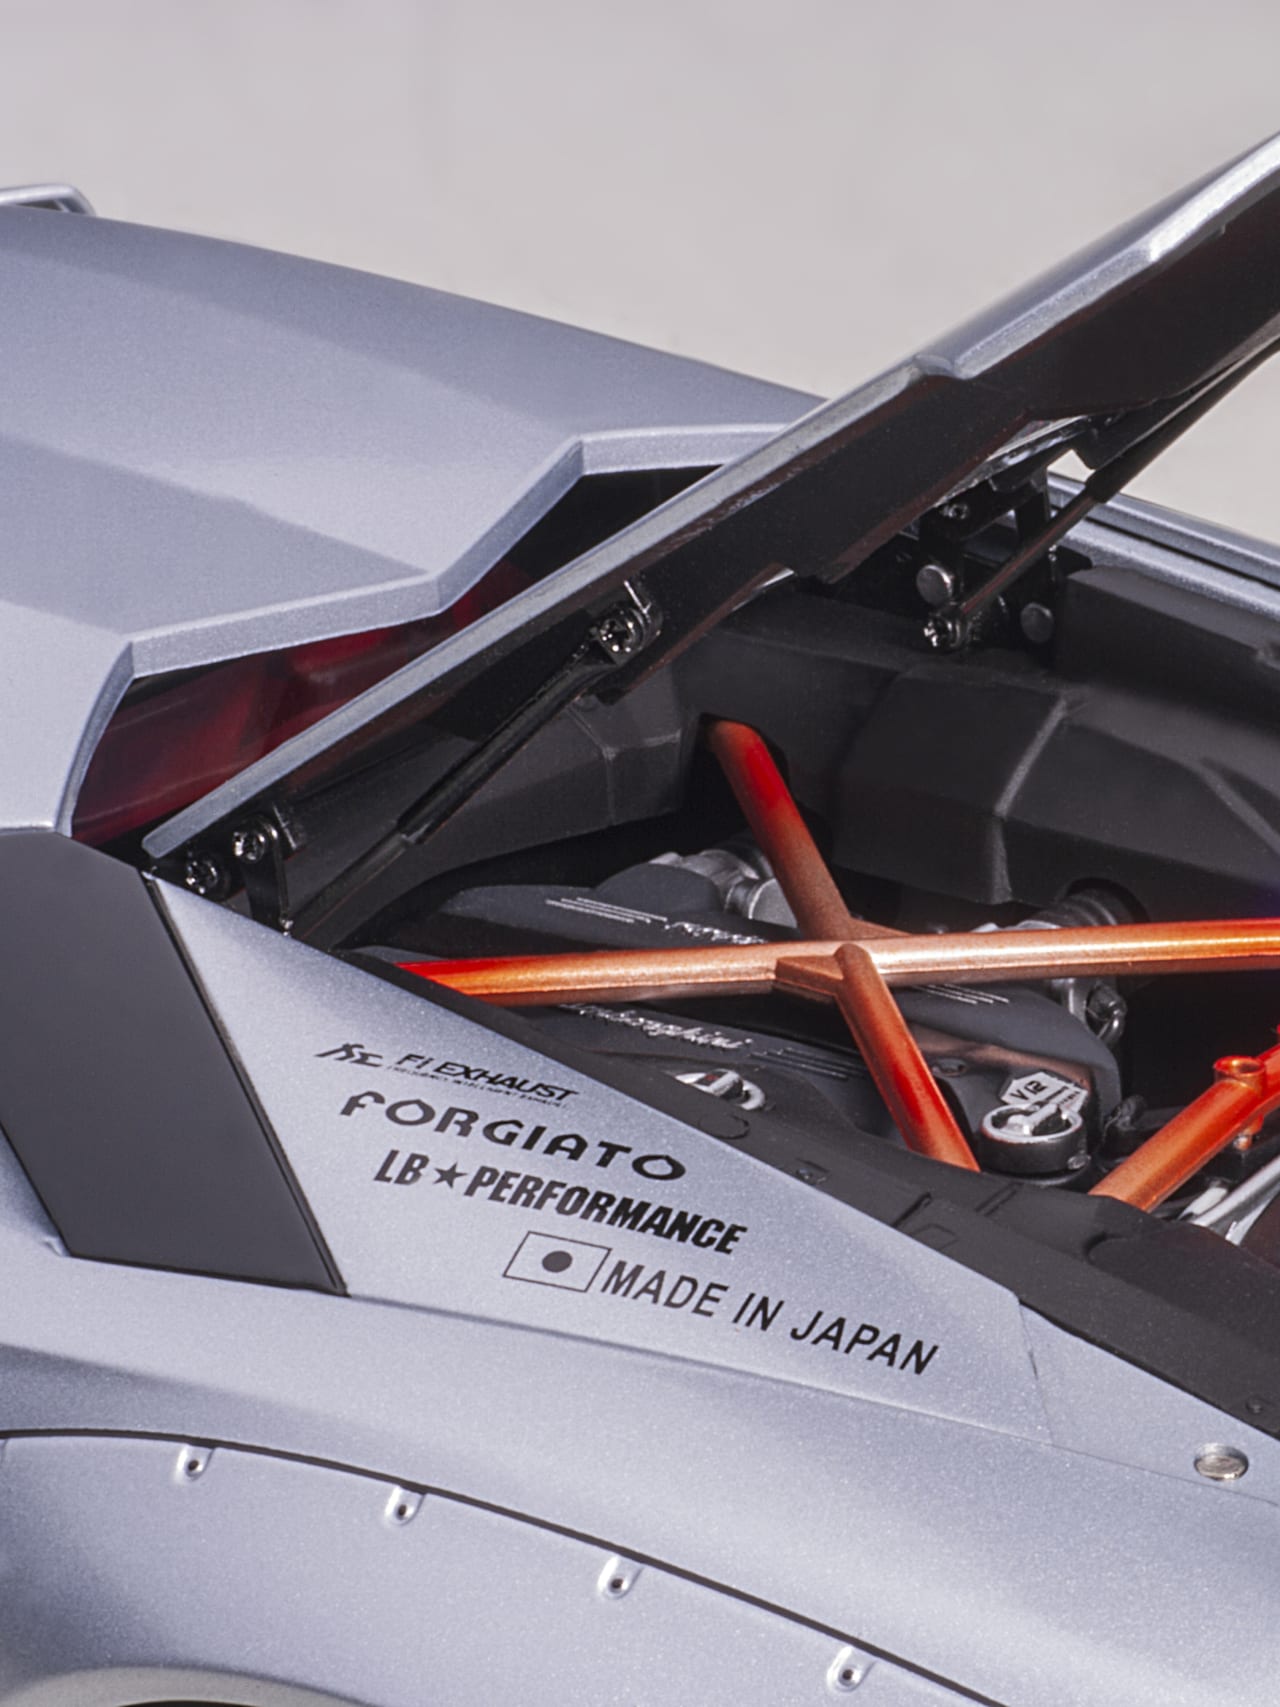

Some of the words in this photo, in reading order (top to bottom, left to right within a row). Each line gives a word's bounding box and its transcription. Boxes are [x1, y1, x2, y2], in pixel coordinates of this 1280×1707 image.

[433, 1063, 579, 1101] EXHAUST
[340, 1090, 686, 1182] FORGIATO
[464, 1164, 748, 1255] PERFORMANCE
[600, 1259, 729, 1318] MADE
[732, 1293, 784, 1331] IN
[790, 1309, 940, 1376] JAPAN
